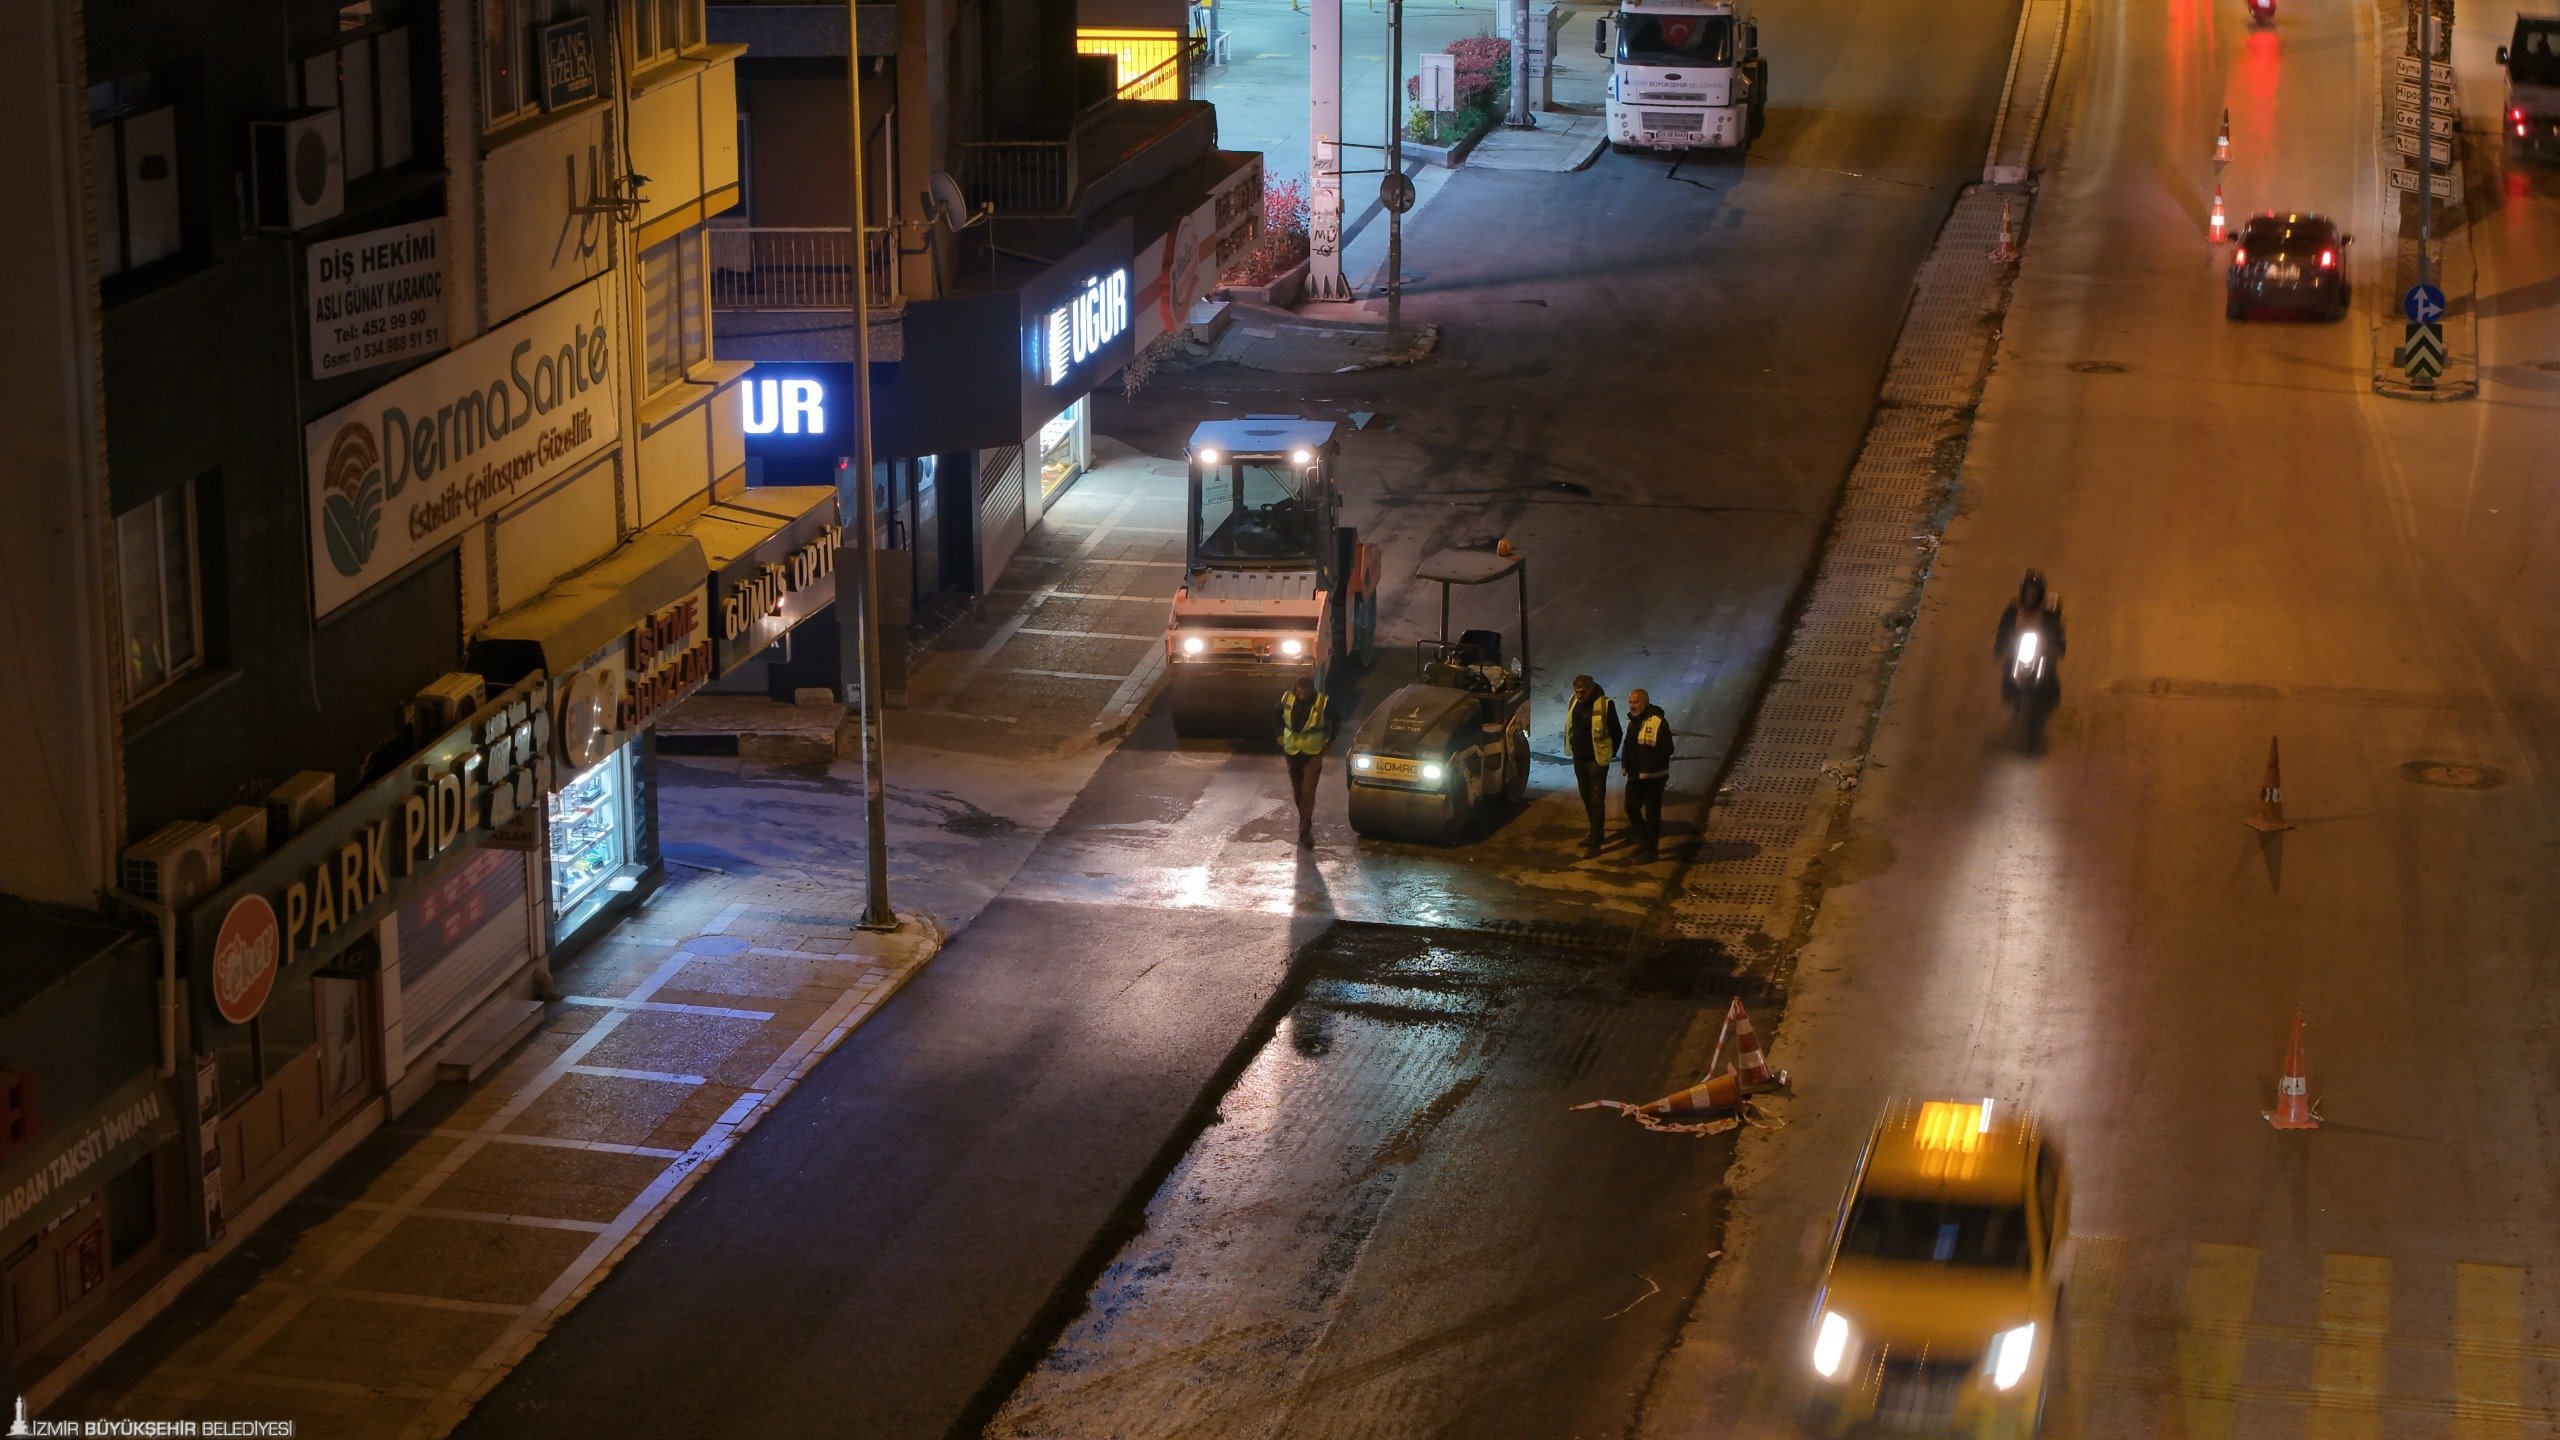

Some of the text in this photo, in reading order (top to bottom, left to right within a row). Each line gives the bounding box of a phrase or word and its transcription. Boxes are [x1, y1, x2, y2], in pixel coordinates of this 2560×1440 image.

[2397, 86, 2442, 104] Hipom
[2397, 111, 2436, 130] Gez
[320, 229, 436, 285] DİŞ HEKİMİ
[316, 271, 442, 323] ASLI GÜNAY KARAKOÇ
[1072, 268, 1128, 364] UĞUR
[322, 327, 438, 370] Gsm: 0 534 988 51 51
[334, 309, 426, 343] Tel: 452 99 90
[382, 309, 608, 502] DermaSanté
[286, 818, 389, 966] PARK
[405, 752, 482, 877] PİDE
[49, 1127, 104, 1189] TAKSİT
